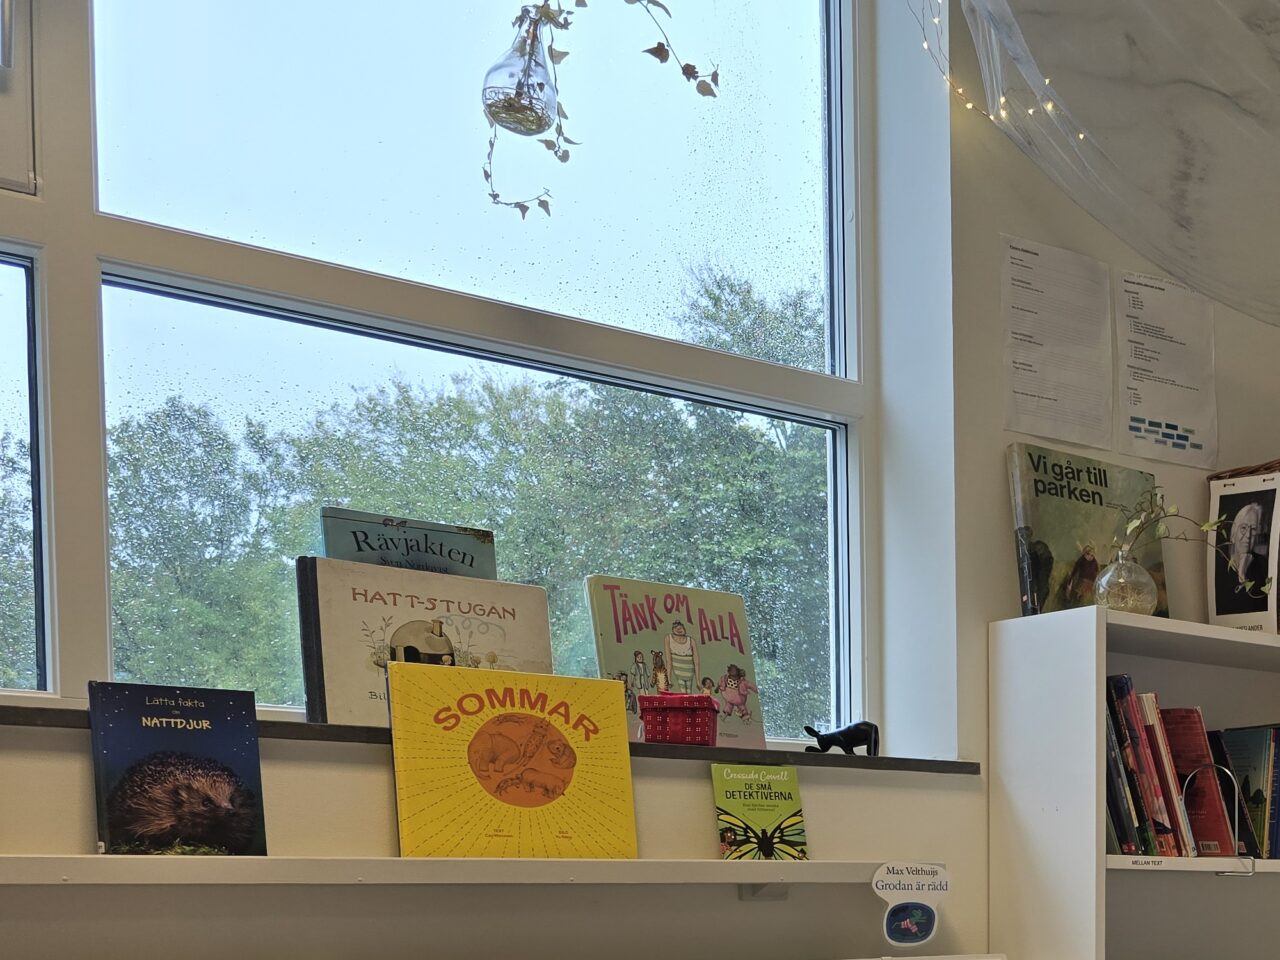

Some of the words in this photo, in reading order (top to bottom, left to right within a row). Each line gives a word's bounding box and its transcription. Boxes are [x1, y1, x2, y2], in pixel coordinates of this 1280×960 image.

[1027, 452, 1048, 475] Vi
[1051, 460, 1085, 483] går
[1085, 466, 1108, 488] till
[1033, 477, 1104, 507] parken
[350, 530, 475, 568] Rävjakten
[351, 587, 516, 620] HATT-STUGAN
[602, 584, 664, 644] TÄNK
[663, 593, 694, 625] OM
[698, 607, 745, 655] ALLA
[145, 696, 176, 707] Lätta
[178, 697, 206, 708] fakta
[433, 687, 600, 742] SOMMAR
[142, 717, 212, 730] NATTDJUR
[723, 767, 759, 782] Cressida
[759, 770, 789, 781] Cowell
[744, 782, 754, 790] DE
[755, 781, 772, 791] SMÅ
[725, 790, 793, 801] DETEKTIVERNA
[886, 866, 904, 876] Max
[906, 866, 938, 877] Velthuijs
[875, 880, 913, 891] Grodan
[915, 881, 926, 891] är
[927, 881, 948, 892] rädd
